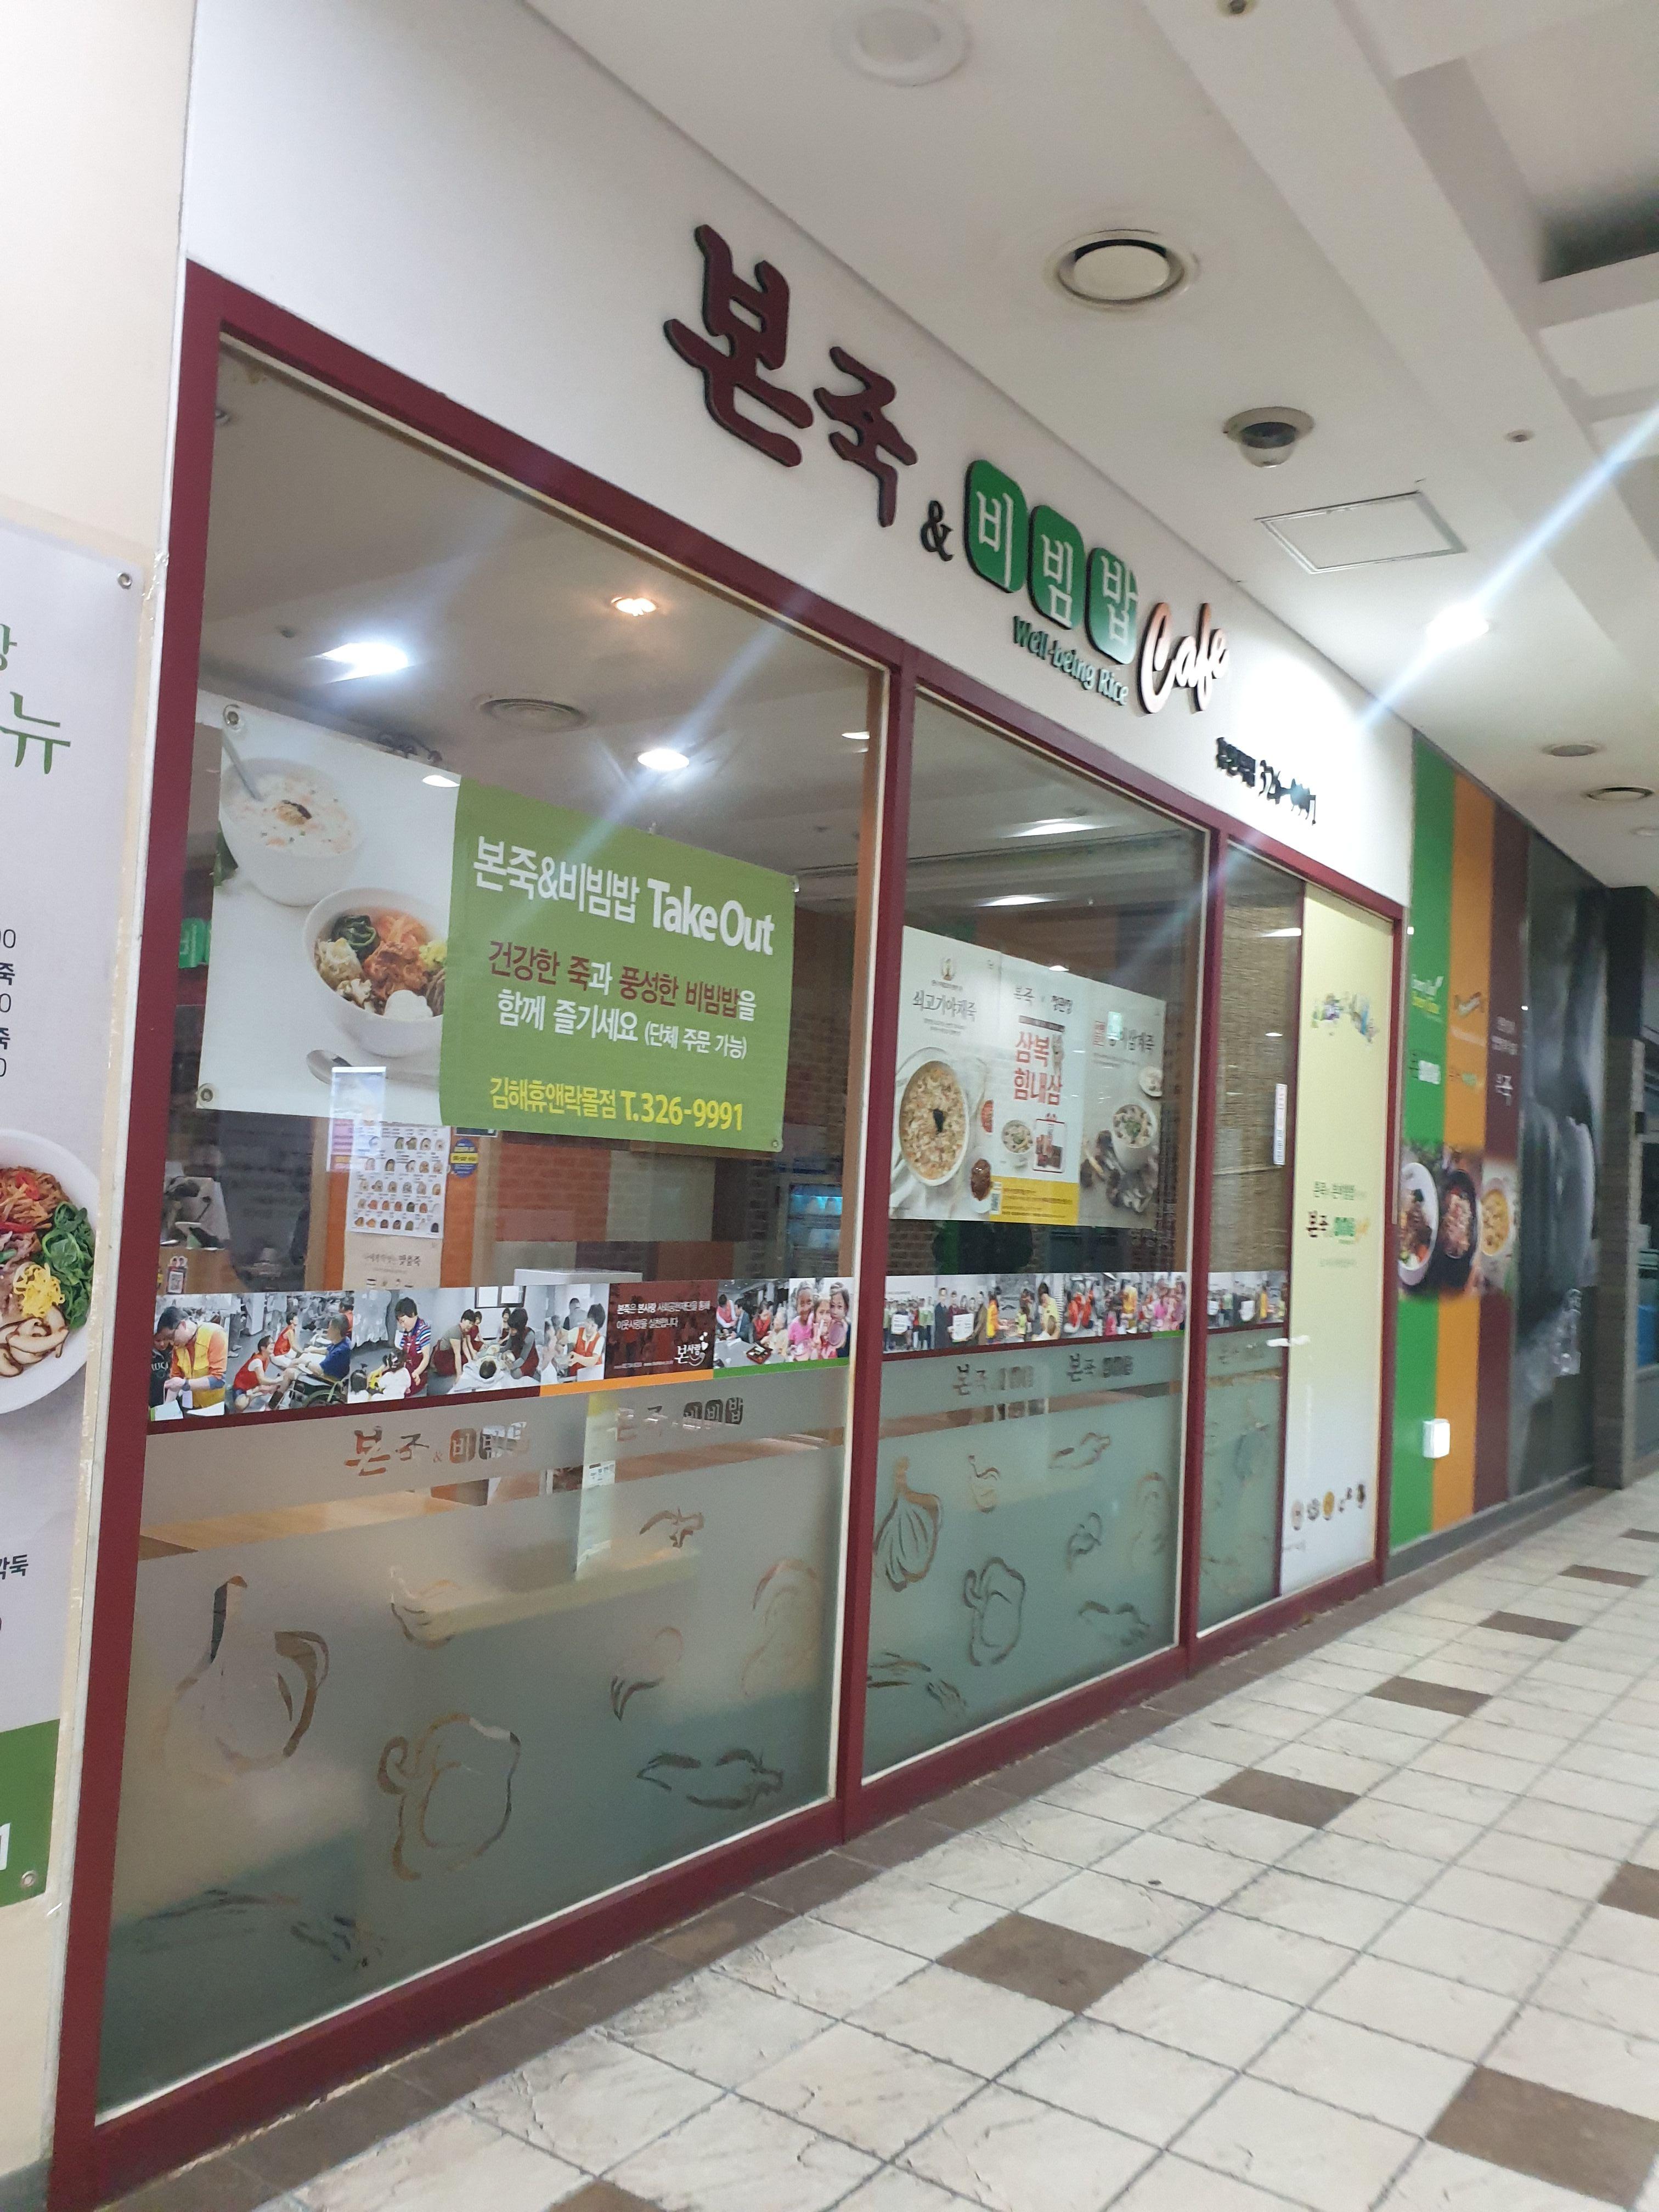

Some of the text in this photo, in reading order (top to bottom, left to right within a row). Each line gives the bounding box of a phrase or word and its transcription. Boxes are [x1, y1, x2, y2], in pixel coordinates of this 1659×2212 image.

[663, 224, 1229, 714] 본죽 & 비빔밥 Cafe
[1013, 616, 1129, 706] Well-being Rice
[473, 836, 641, 924] 본죽&비빔밥
[489, 941, 757, 1022] 건강한 죽과 풍성한 비빔밥을
[498, 989, 747, 1060] 함께 즐기세요 (단체 주문 가능)
[490, 1076, 743, 1131] 김해휴앤락몰점 T.326-9991
